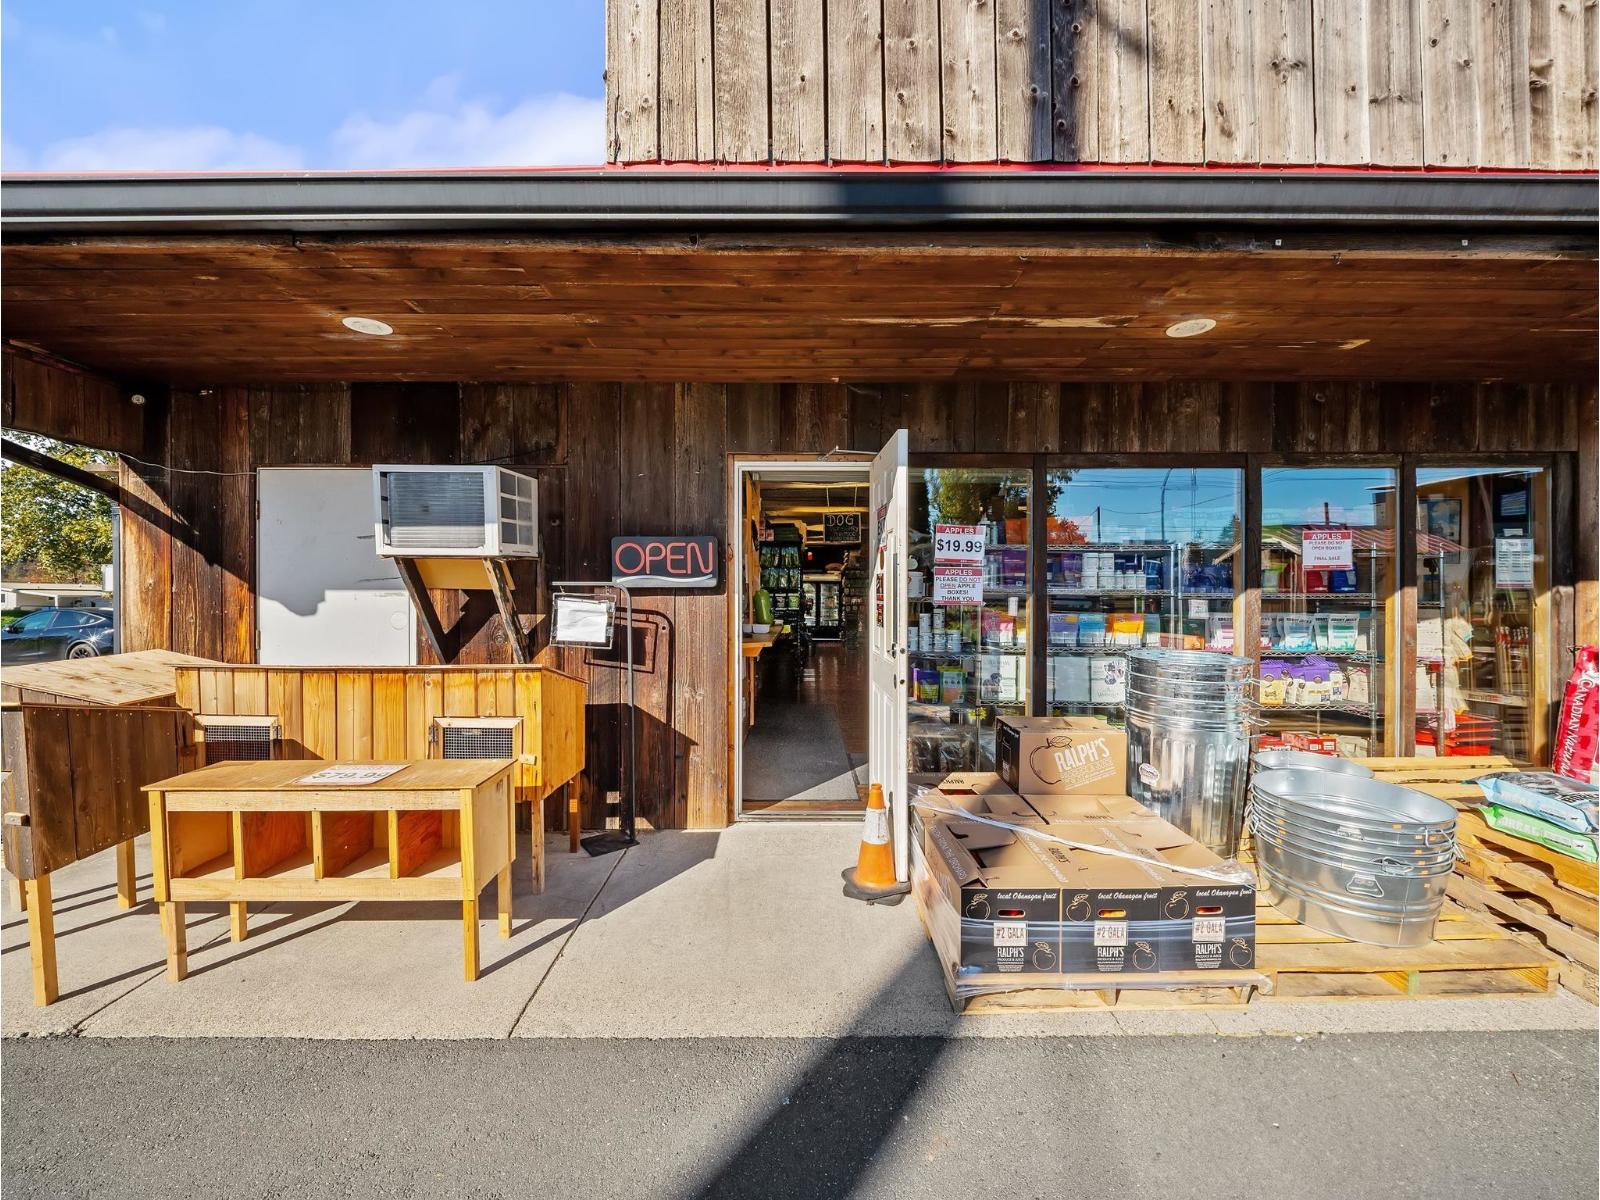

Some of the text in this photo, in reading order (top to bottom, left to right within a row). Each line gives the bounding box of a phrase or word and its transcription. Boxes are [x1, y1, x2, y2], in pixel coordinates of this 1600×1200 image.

[826, 514, 854, 526] DOG
[936, 538, 982, 553] $19.99
[614, 542, 713, 574] OPEN
[1568, 678, 1595, 732] CANADIAN
[1054, 737, 1110, 772] RALPH'S
[1012, 892, 1042, 901] Okanagan
[1042, 892, 1057, 901] fruit
[1113, 892, 1142, 900] Okanagan
[1143, 892, 1158, 900] fruit
[1195, 889, 1210, 897] local
[1211, 889, 1240, 897] Okanagan
[996, 927, 1024, 938] #2 GALA
[1096, 927, 1124, 938] #2 GALA
[1195, 921, 1223, 933] #2 GALA
[997, 947, 1025, 957] RALPH'S
[1097, 946, 1125, 957] RALPH'S
[1195, 943, 1222, 954] RALPH'S
